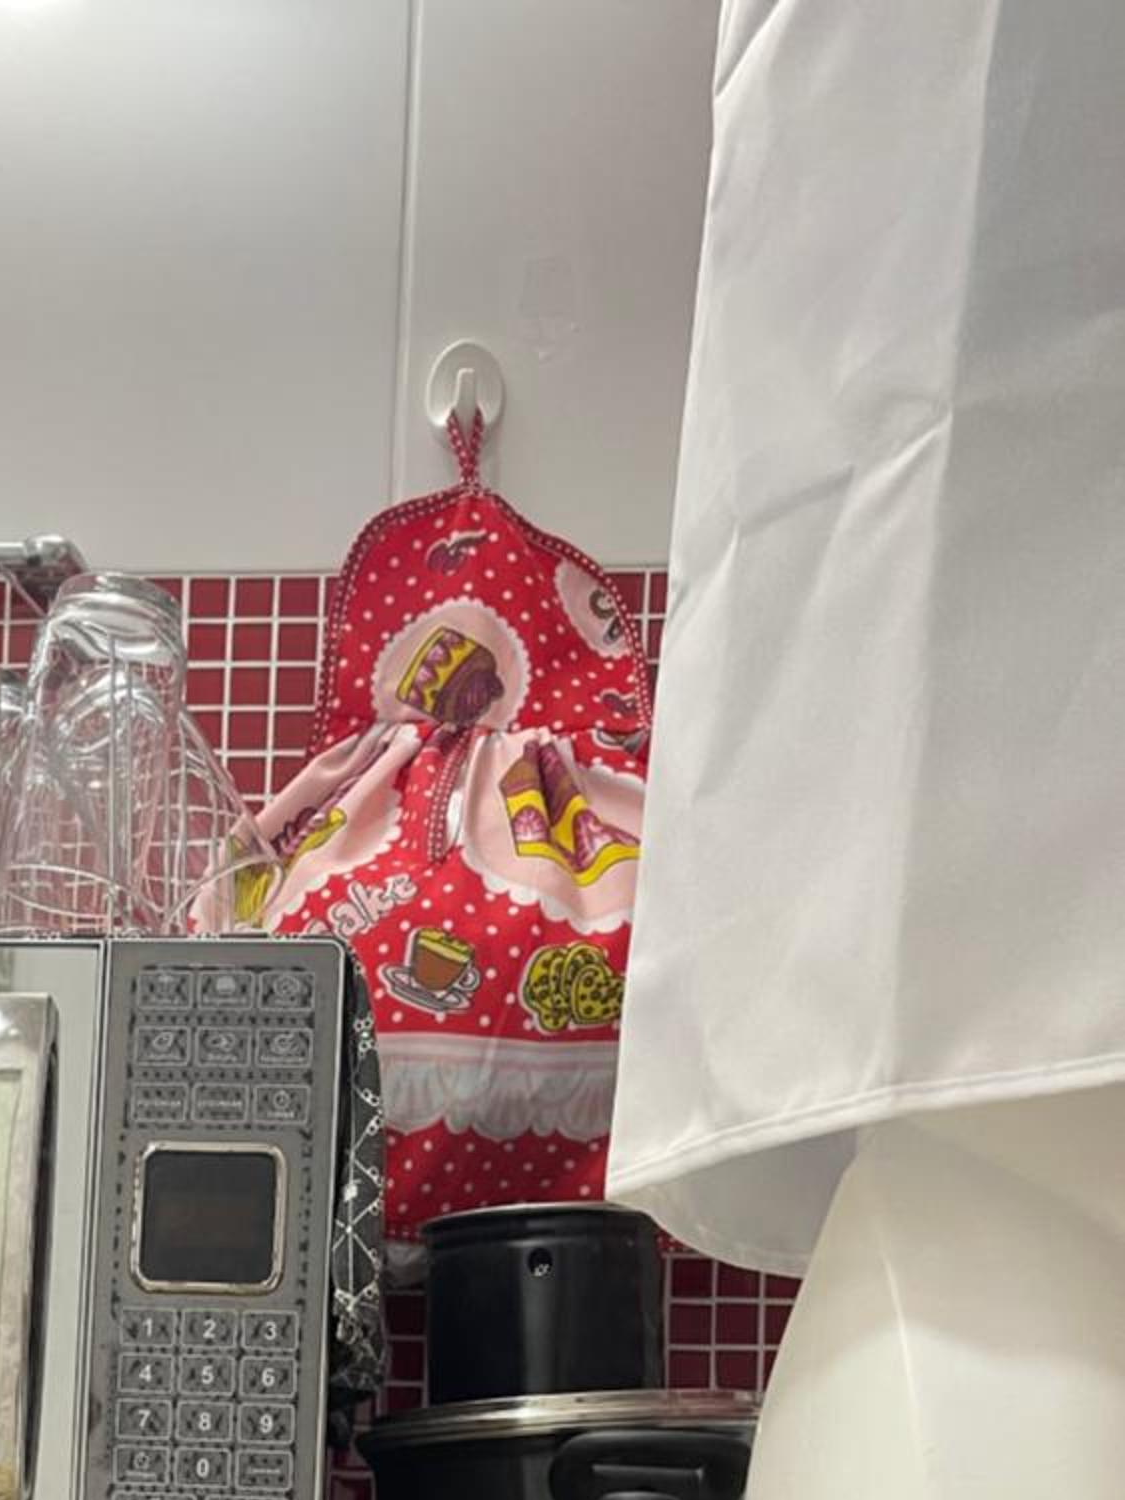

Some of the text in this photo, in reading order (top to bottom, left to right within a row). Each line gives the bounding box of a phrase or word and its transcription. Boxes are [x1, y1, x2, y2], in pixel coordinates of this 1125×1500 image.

[142, 1318, 154, 1337] 1
[203, 1320, 216, 1339] 2
[264, 1321, 277, 1340] 3
[138, 1364, 152, 1383] 4
[202, 1366, 214, 1384] 5
[262, 1367, 275, 1386] 6
[138, 1409, 151, 1428] 7
[198, 1412, 212, 1431] 8
[260, 1415, 273, 1434] 9
[196, 1458, 209, 1478] 0
